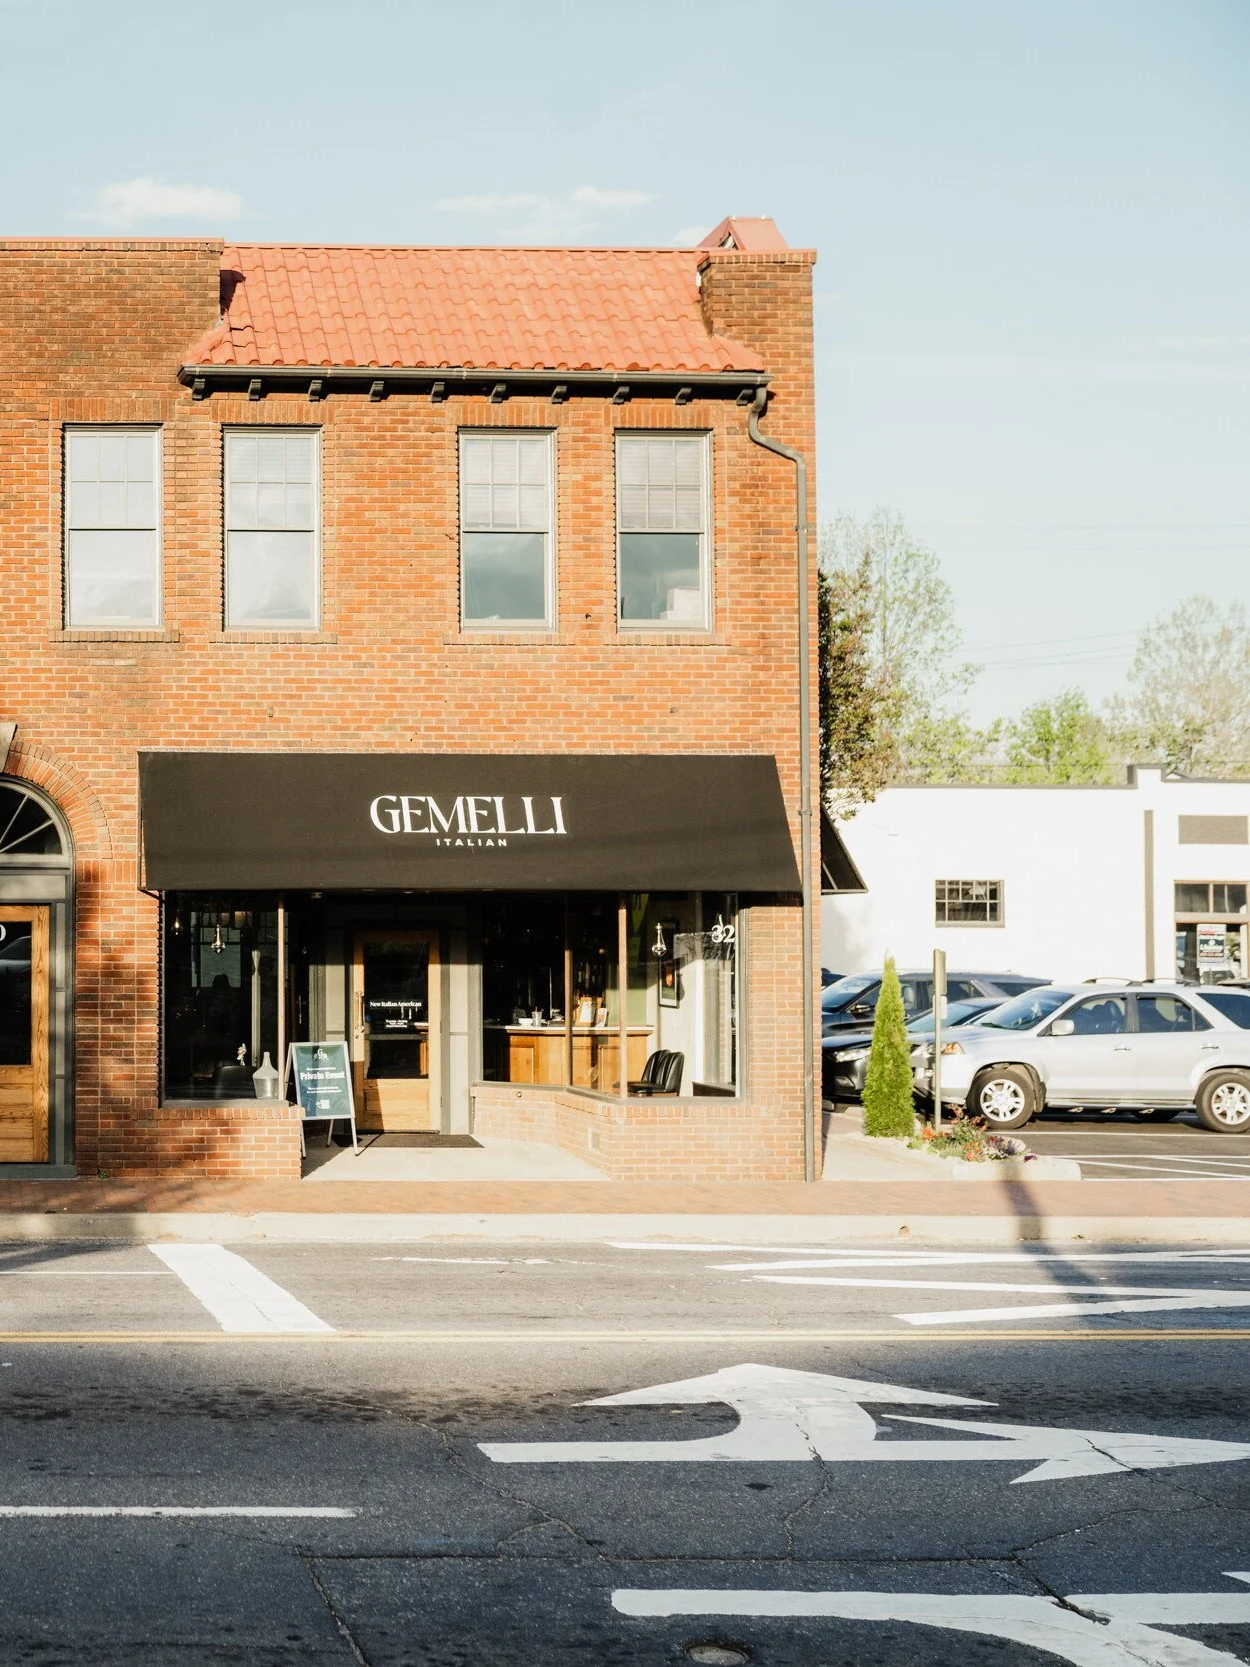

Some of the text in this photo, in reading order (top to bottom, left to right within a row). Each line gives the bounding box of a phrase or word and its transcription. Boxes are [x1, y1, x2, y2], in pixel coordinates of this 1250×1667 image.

[369, 795, 567, 834] GEMELLI
[436, 838, 507, 847] ITALIAN
[711, 924, 735, 943] 32
[300, 1071, 345, 1080] Private Event
